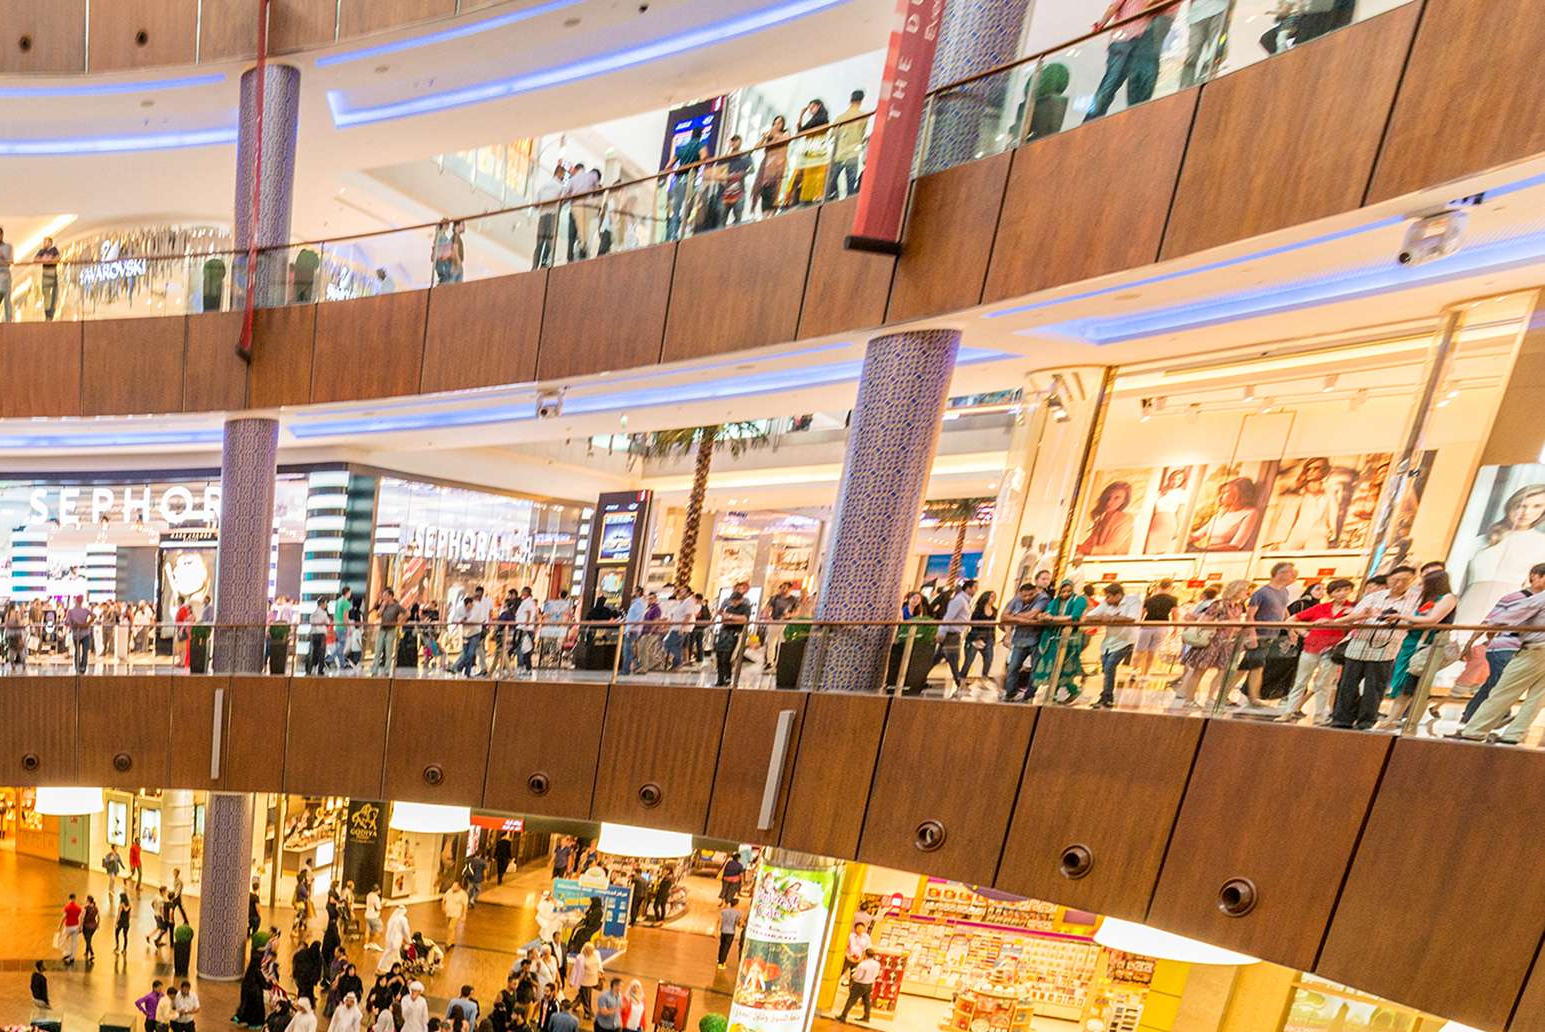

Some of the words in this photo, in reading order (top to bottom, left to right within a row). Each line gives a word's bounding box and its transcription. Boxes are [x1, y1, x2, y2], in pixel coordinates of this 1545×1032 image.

[887, 56, 913, 120] THE
[79, 259, 146, 286] SWAROVSKI
[412, 526, 502, 562] SEPHORA
[350, 828, 378, 839] GODIVA
